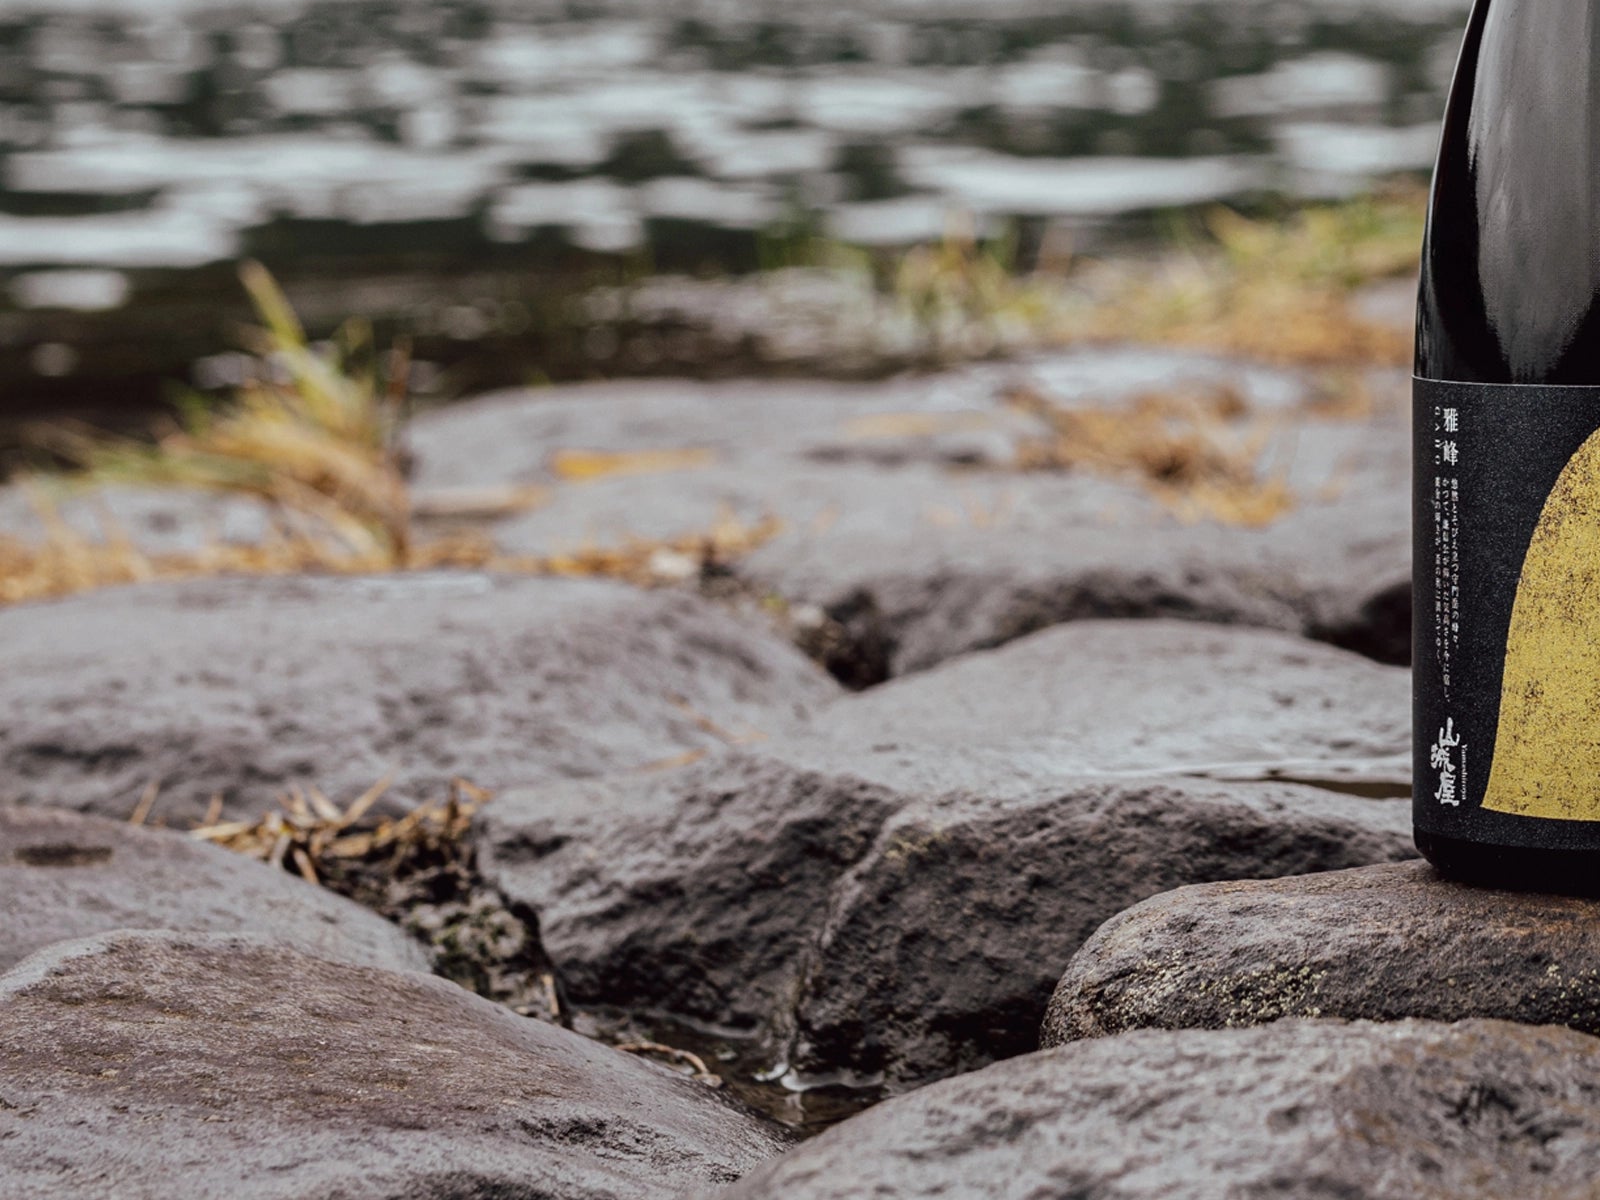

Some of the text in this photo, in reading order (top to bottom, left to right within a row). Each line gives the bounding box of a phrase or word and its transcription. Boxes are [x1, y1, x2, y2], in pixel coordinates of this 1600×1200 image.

[1442, 407, 1459, 467] 雅峰
[1430, 716, 1460, 808] 山城屋
